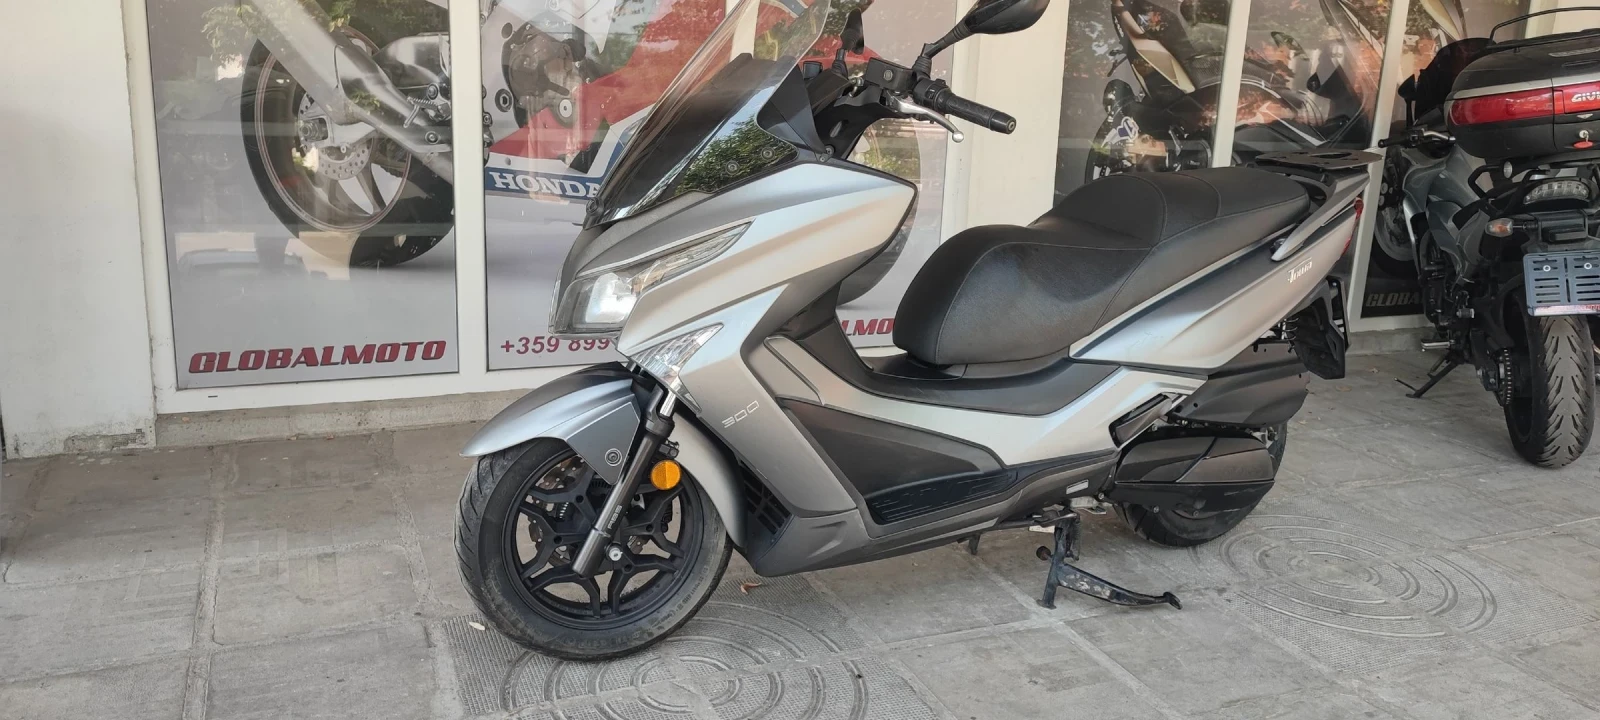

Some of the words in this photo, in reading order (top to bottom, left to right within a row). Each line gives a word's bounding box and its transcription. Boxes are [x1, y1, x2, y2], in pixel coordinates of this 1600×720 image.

[188, 340, 447, 374] GLOBALMOTO
[500, 336, 560, 355] +359
[721, 400, 760, 429] 300
